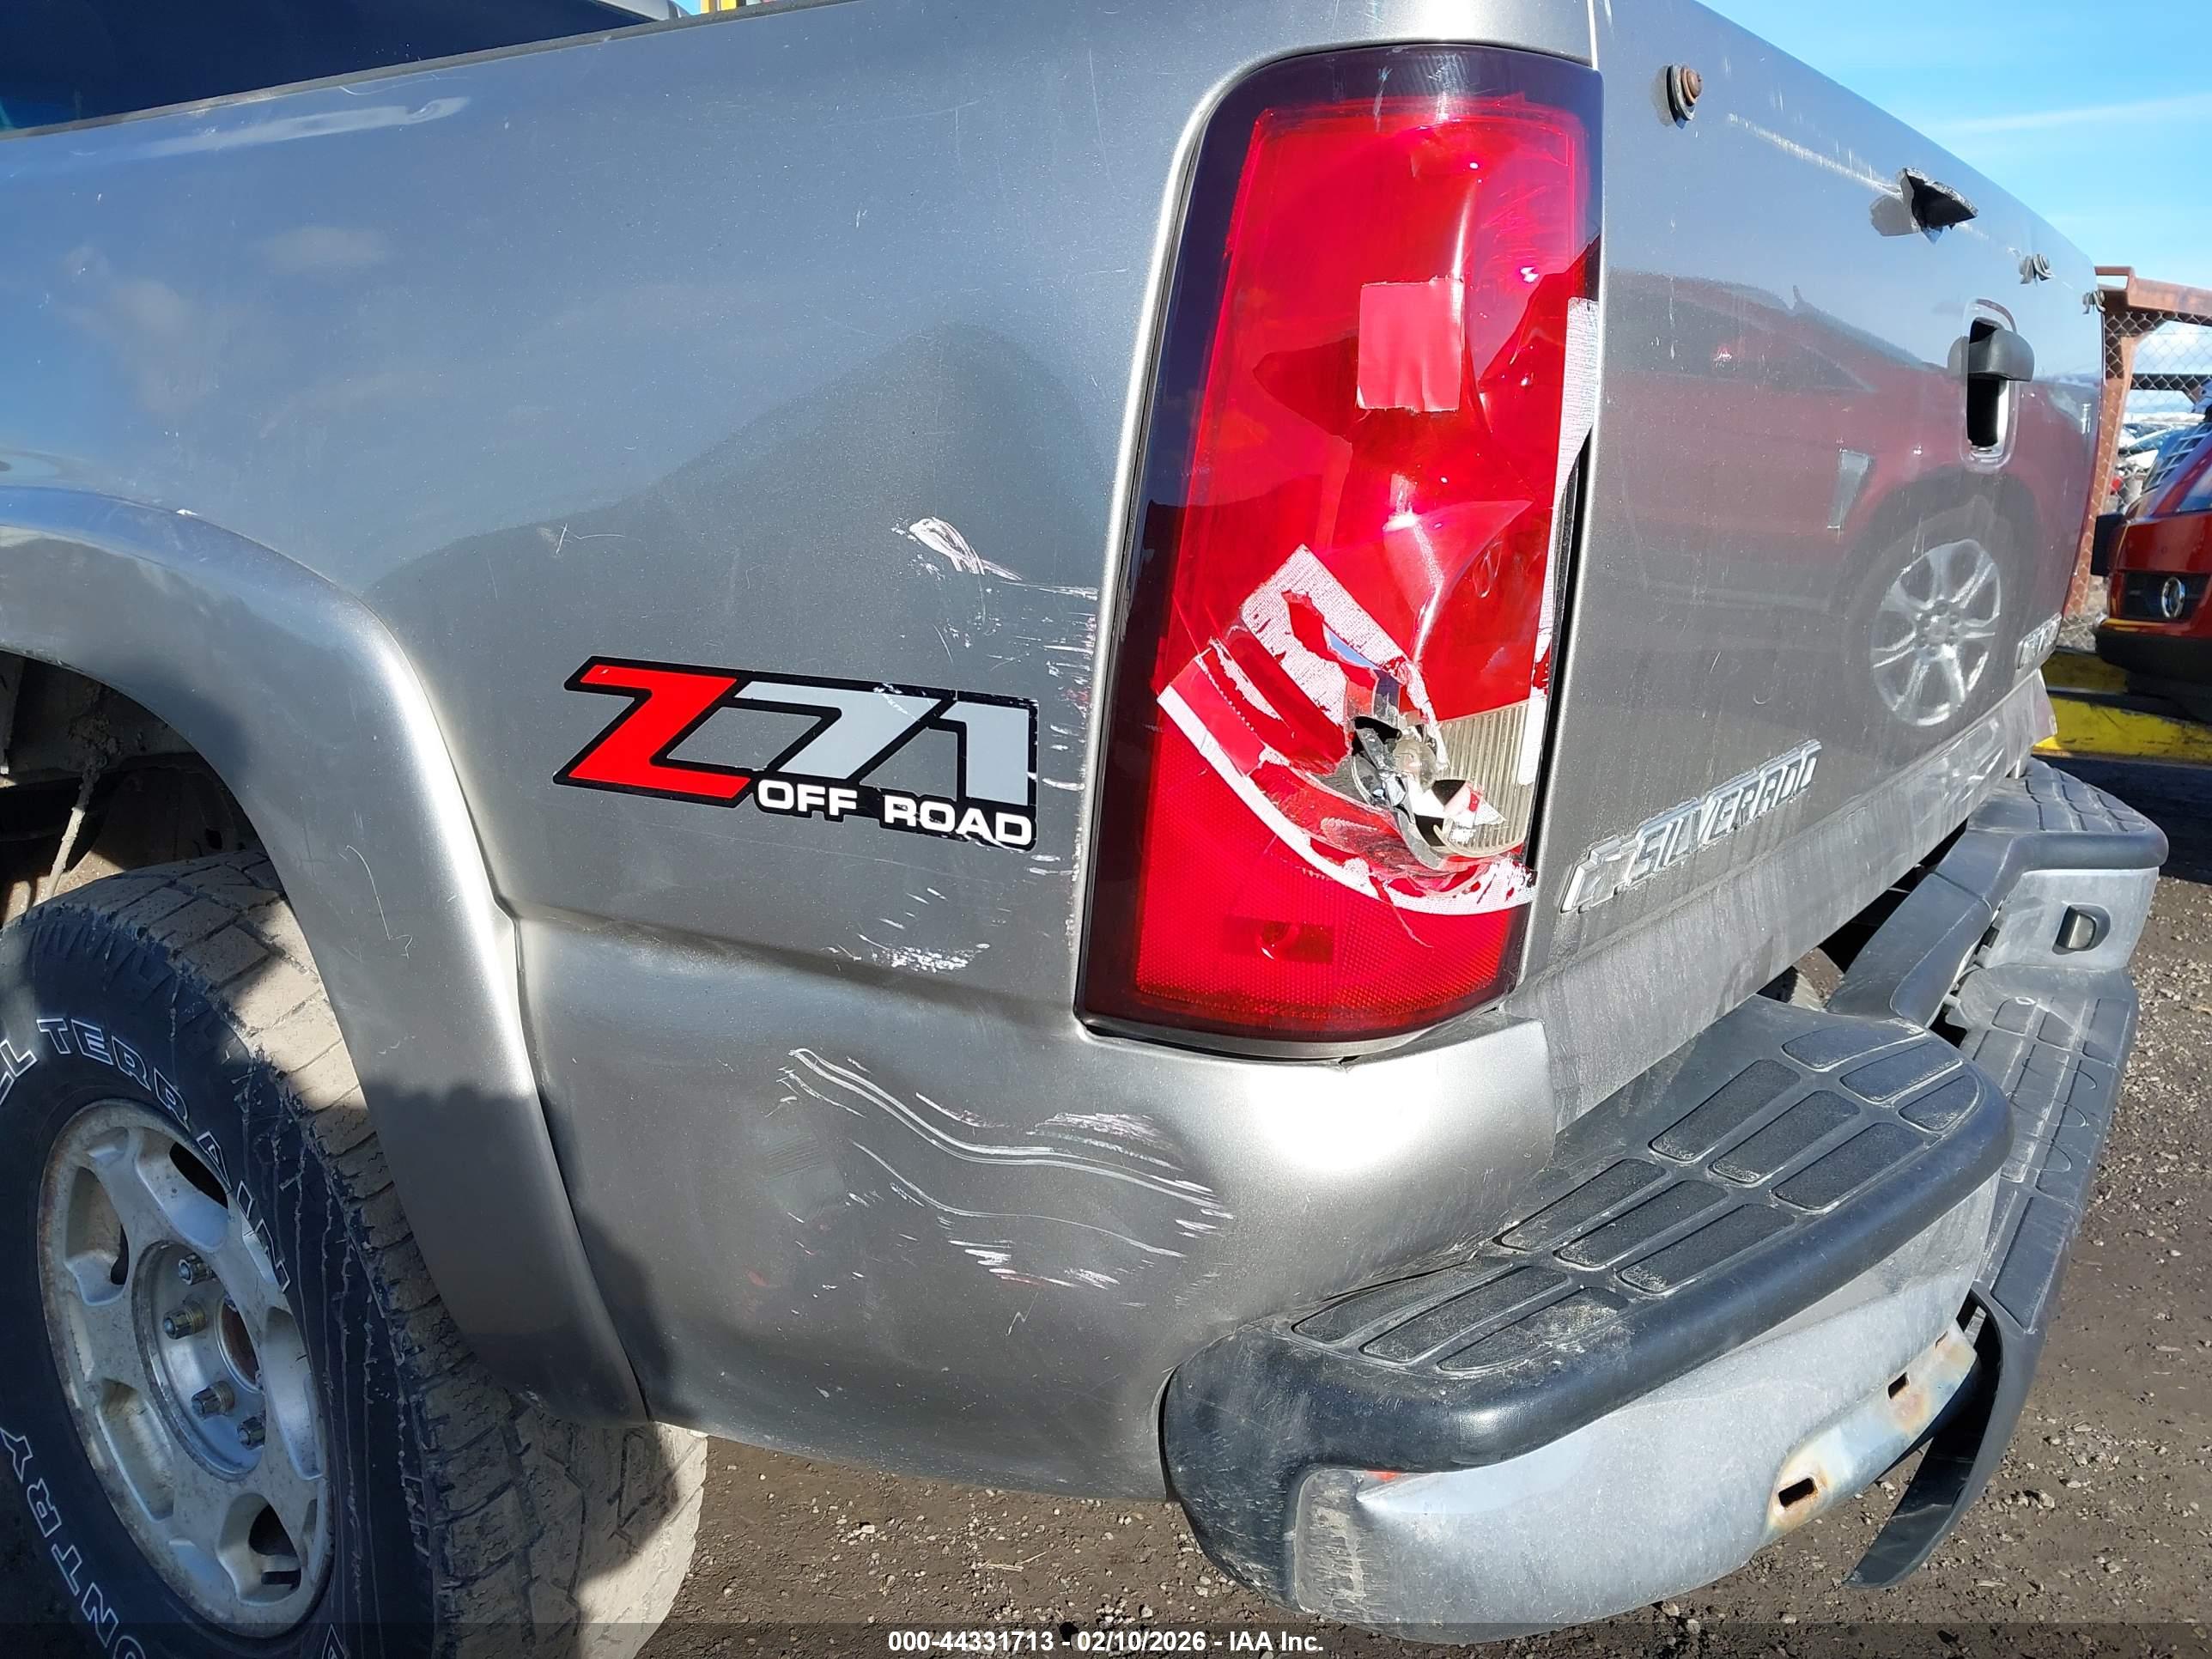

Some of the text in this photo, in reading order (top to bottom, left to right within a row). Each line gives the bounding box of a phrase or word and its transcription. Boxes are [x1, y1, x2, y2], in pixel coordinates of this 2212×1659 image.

[556, 657, 1036, 805] Z71
[757, 779, 1032, 847] OFF ROAD
[36, 1017, 291, 1293] TERRAIN
